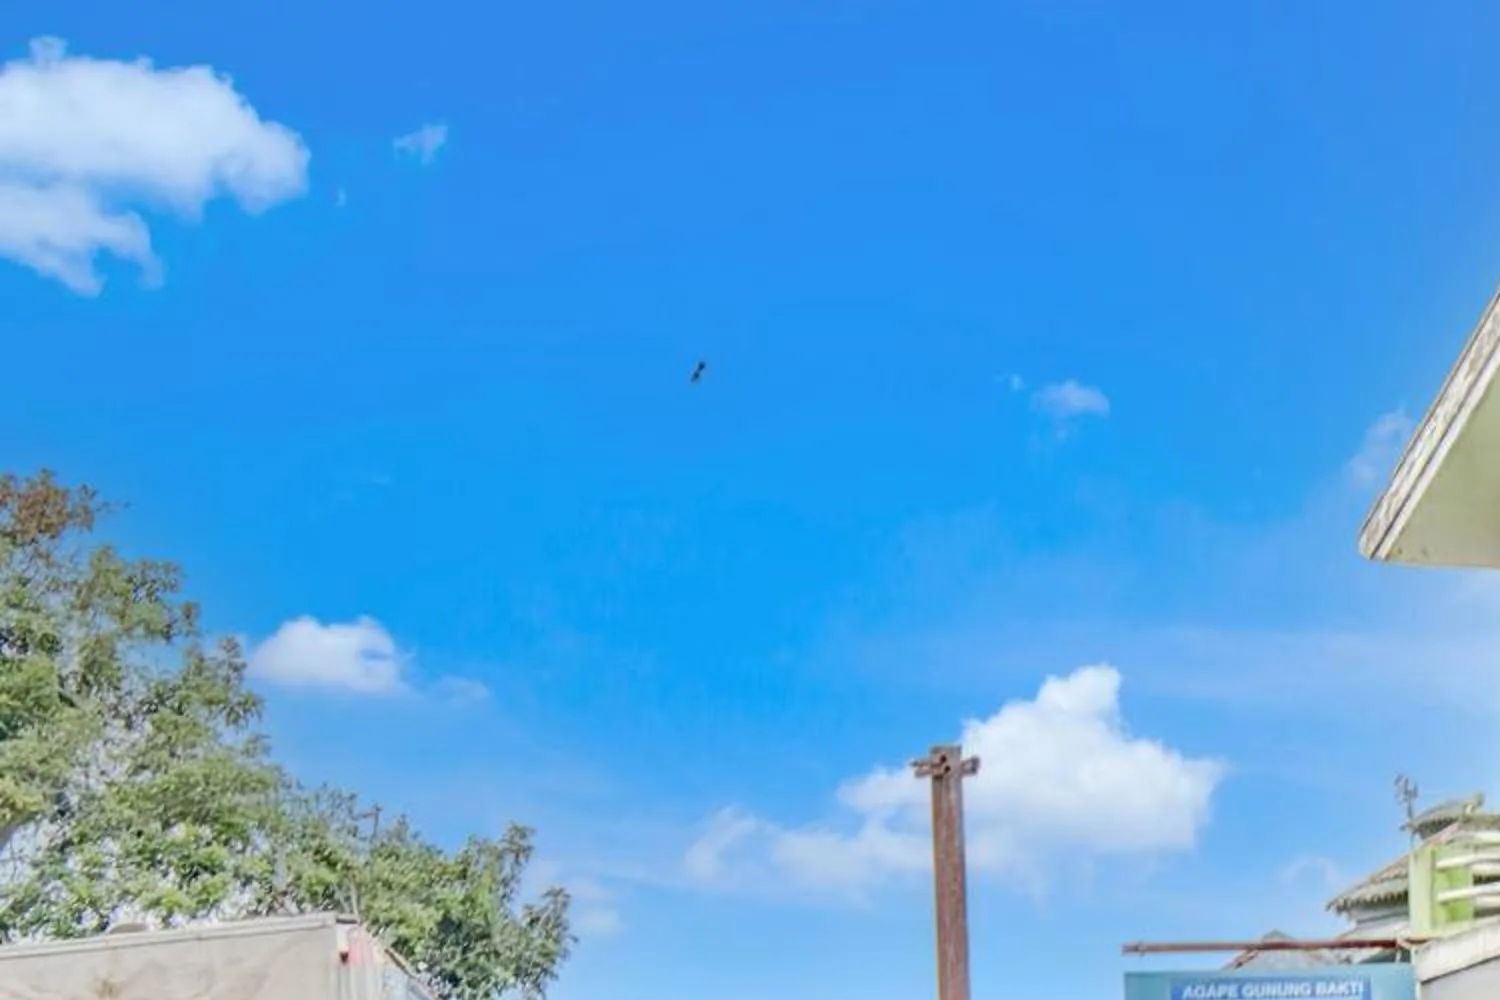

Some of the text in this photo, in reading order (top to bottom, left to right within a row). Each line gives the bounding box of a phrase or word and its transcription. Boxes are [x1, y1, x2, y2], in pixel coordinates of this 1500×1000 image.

[1182, 979, 1364, 1000] AGAPE GUNUNG BAKTI
